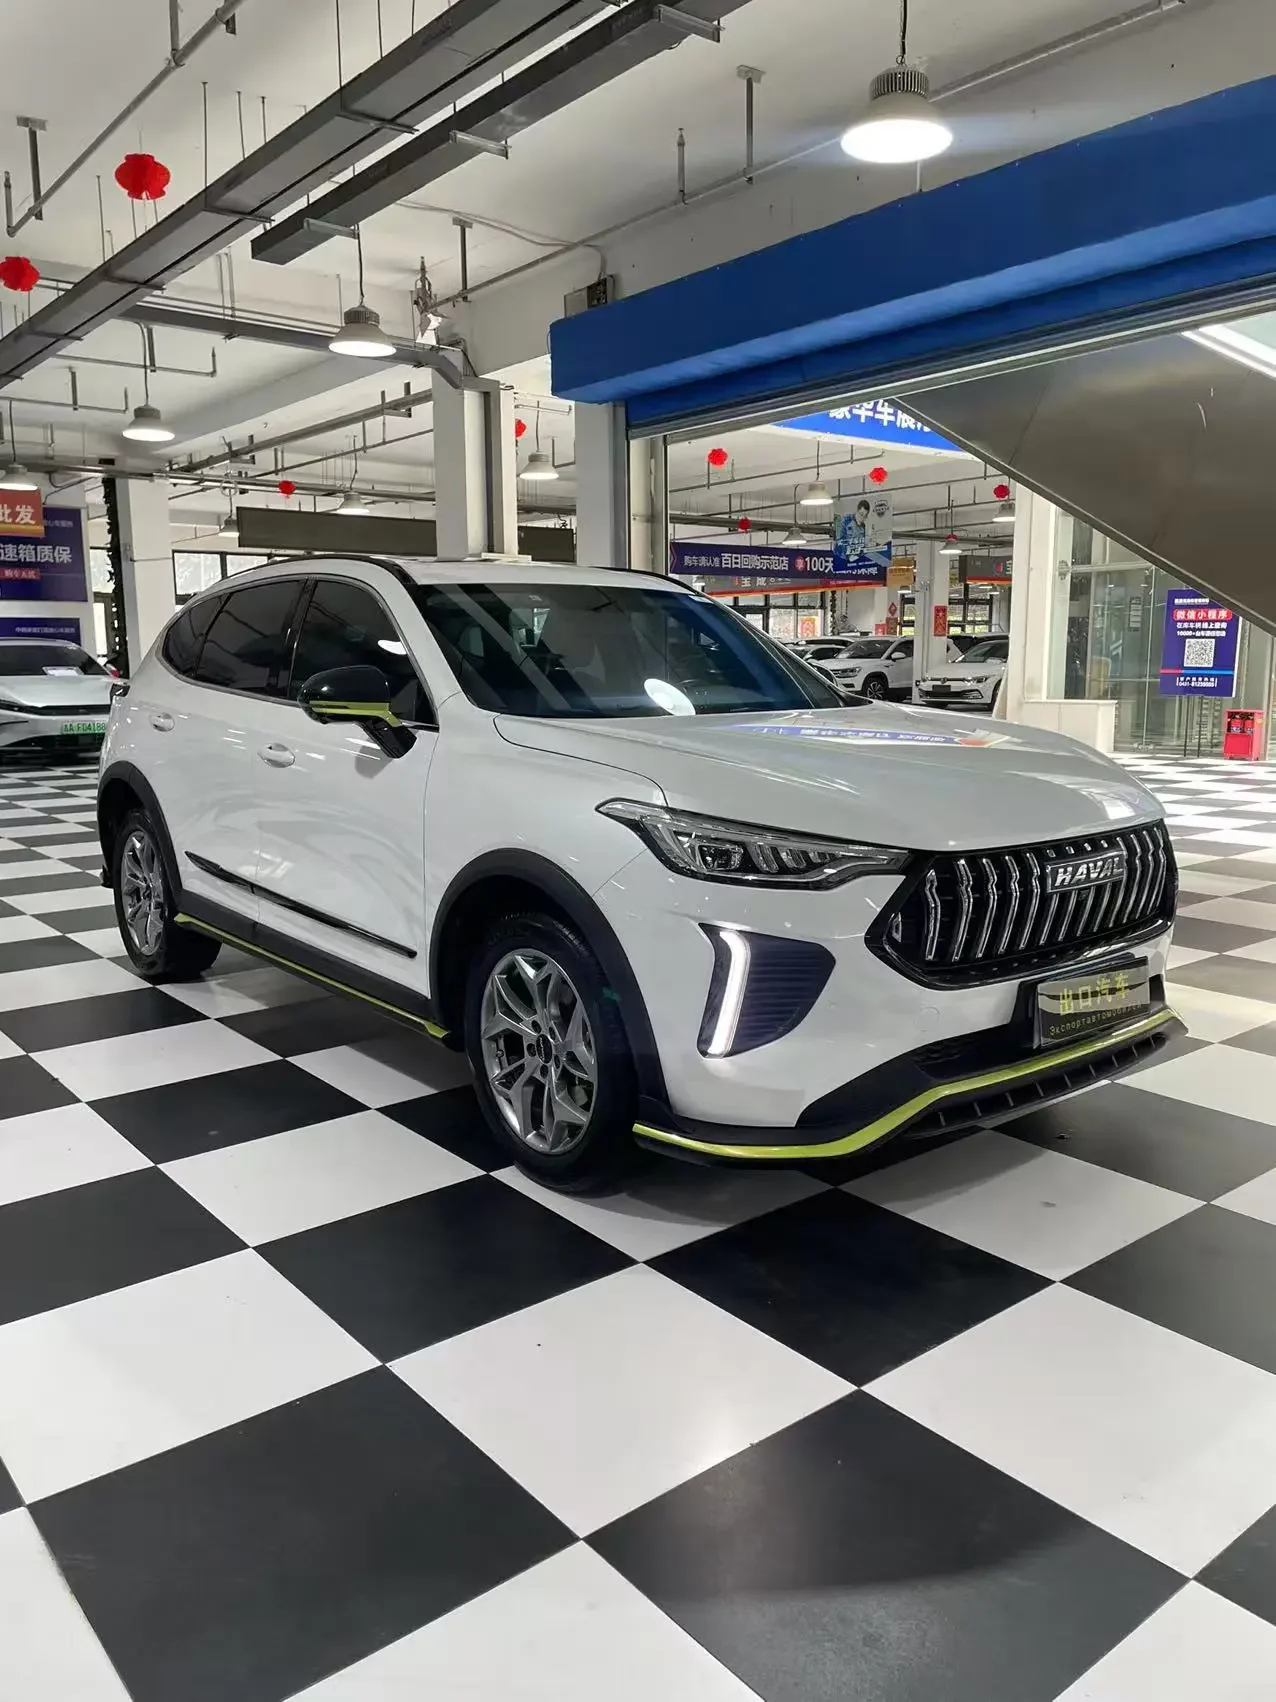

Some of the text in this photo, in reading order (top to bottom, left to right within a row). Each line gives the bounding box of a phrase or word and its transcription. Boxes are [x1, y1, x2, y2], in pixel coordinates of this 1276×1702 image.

[829, 400, 931, 432] 豪华车展
[721, 553, 789, 571] 百日回购示范店
[1176, 609, 1228, 620] 微信小程序
[1055, 857, 1124, 887] HAVAL
[1060, 973, 1129, 1016] 出口汽车
